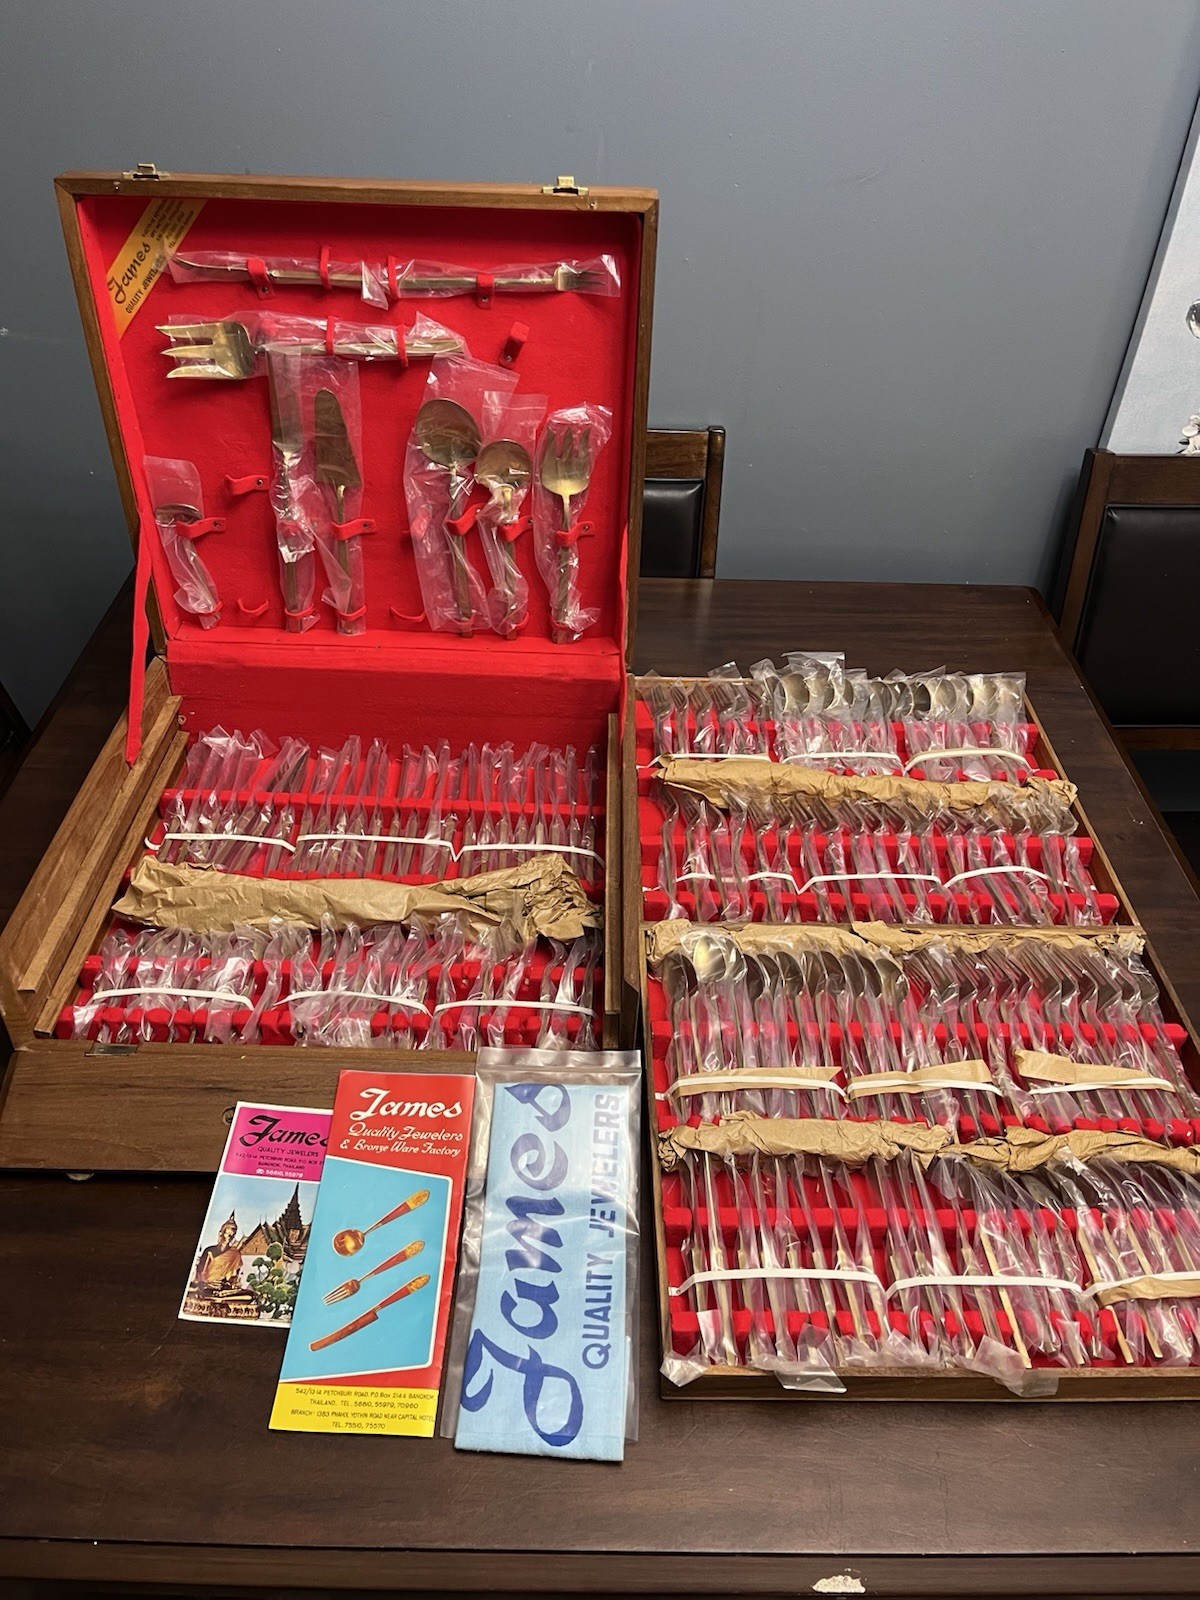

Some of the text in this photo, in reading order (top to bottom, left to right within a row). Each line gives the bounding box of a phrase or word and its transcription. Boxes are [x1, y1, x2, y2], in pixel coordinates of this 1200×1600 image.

[108, 242, 151, 304] James
[125, 290, 144, 314] QUALITY
[349, 1087, 462, 1120] James
[348, 1121, 463, 1141] Quality Jewelers
[258, 1146, 319, 1158] QUALITY JEWELERS
[340, 1138, 461, 1157] & Bronze Ware Factory
[582, 1094, 620, 1370] QUALITY JEWELERS
[460, 1083, 584, 1447] James
